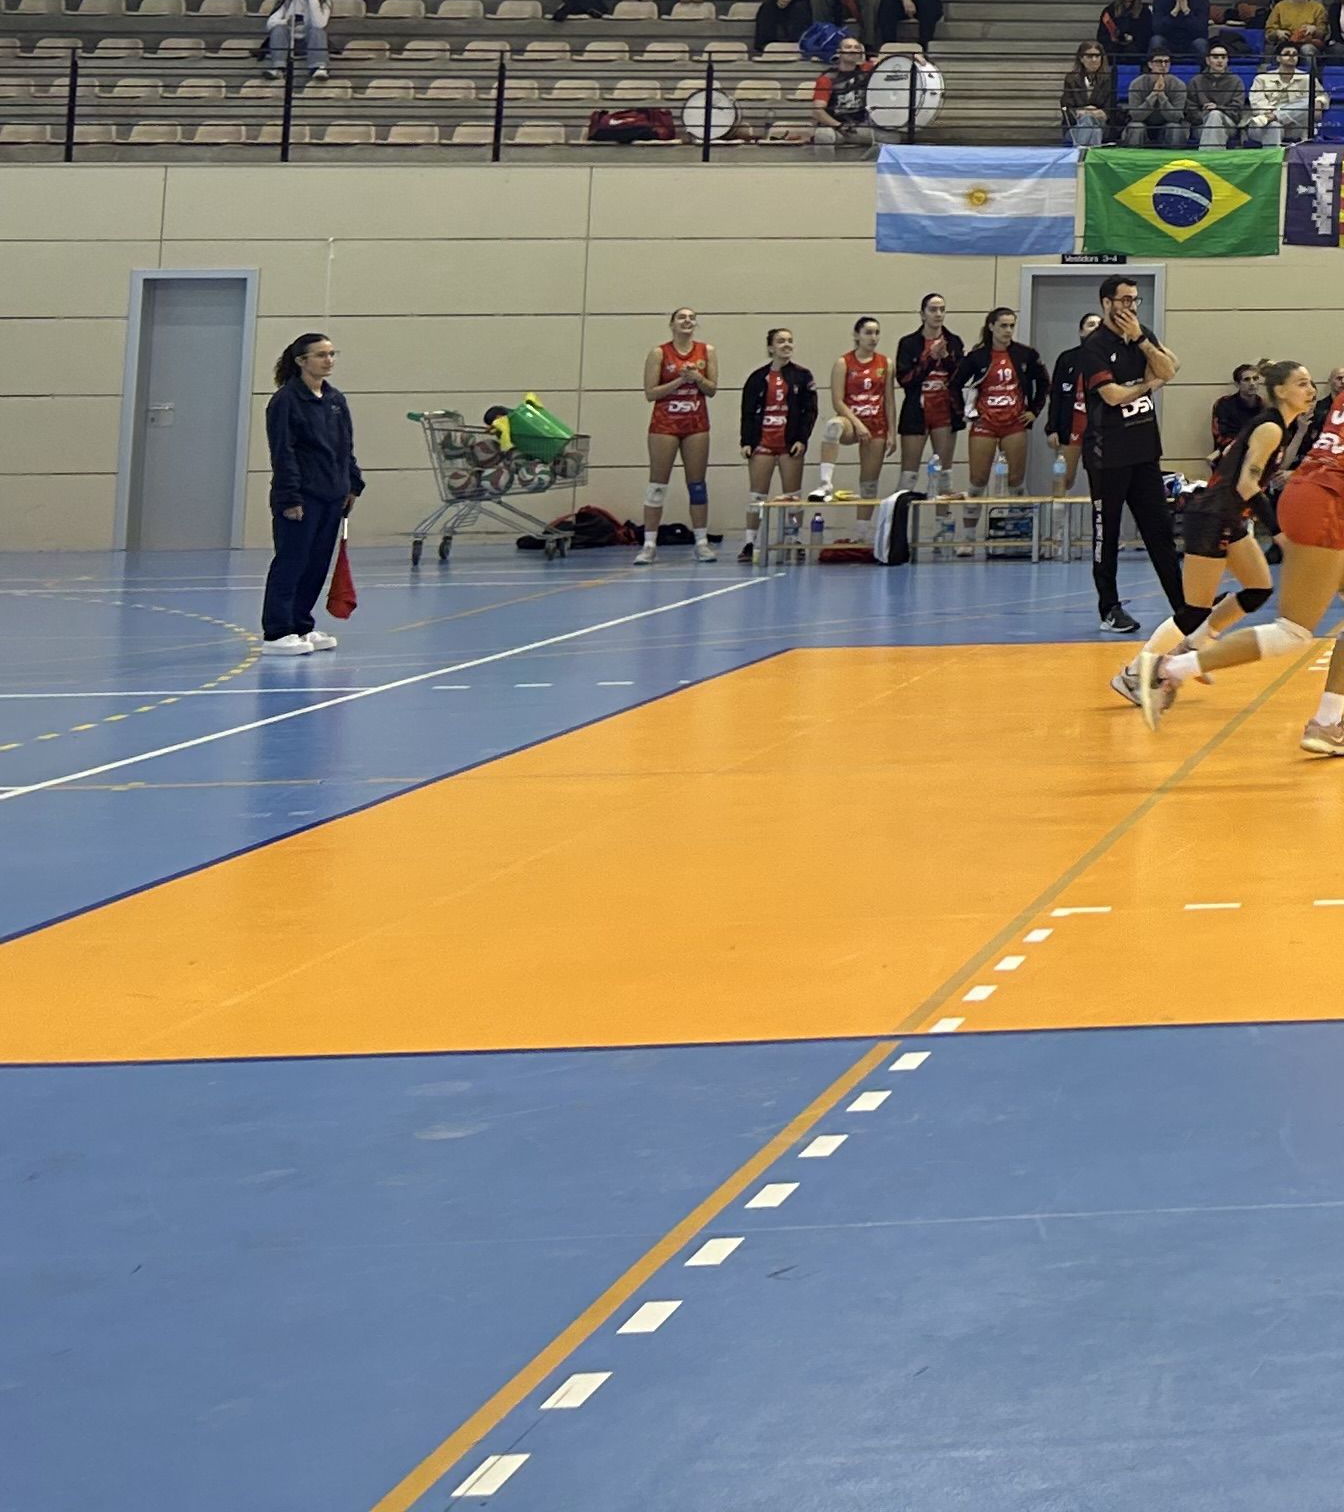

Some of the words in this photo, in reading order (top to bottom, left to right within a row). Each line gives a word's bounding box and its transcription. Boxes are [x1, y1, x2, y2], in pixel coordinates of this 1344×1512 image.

[997, 368, 1013, 380] 19
[776, 390, 784, 401] 5
[668, 400, 700, 412] DSV
